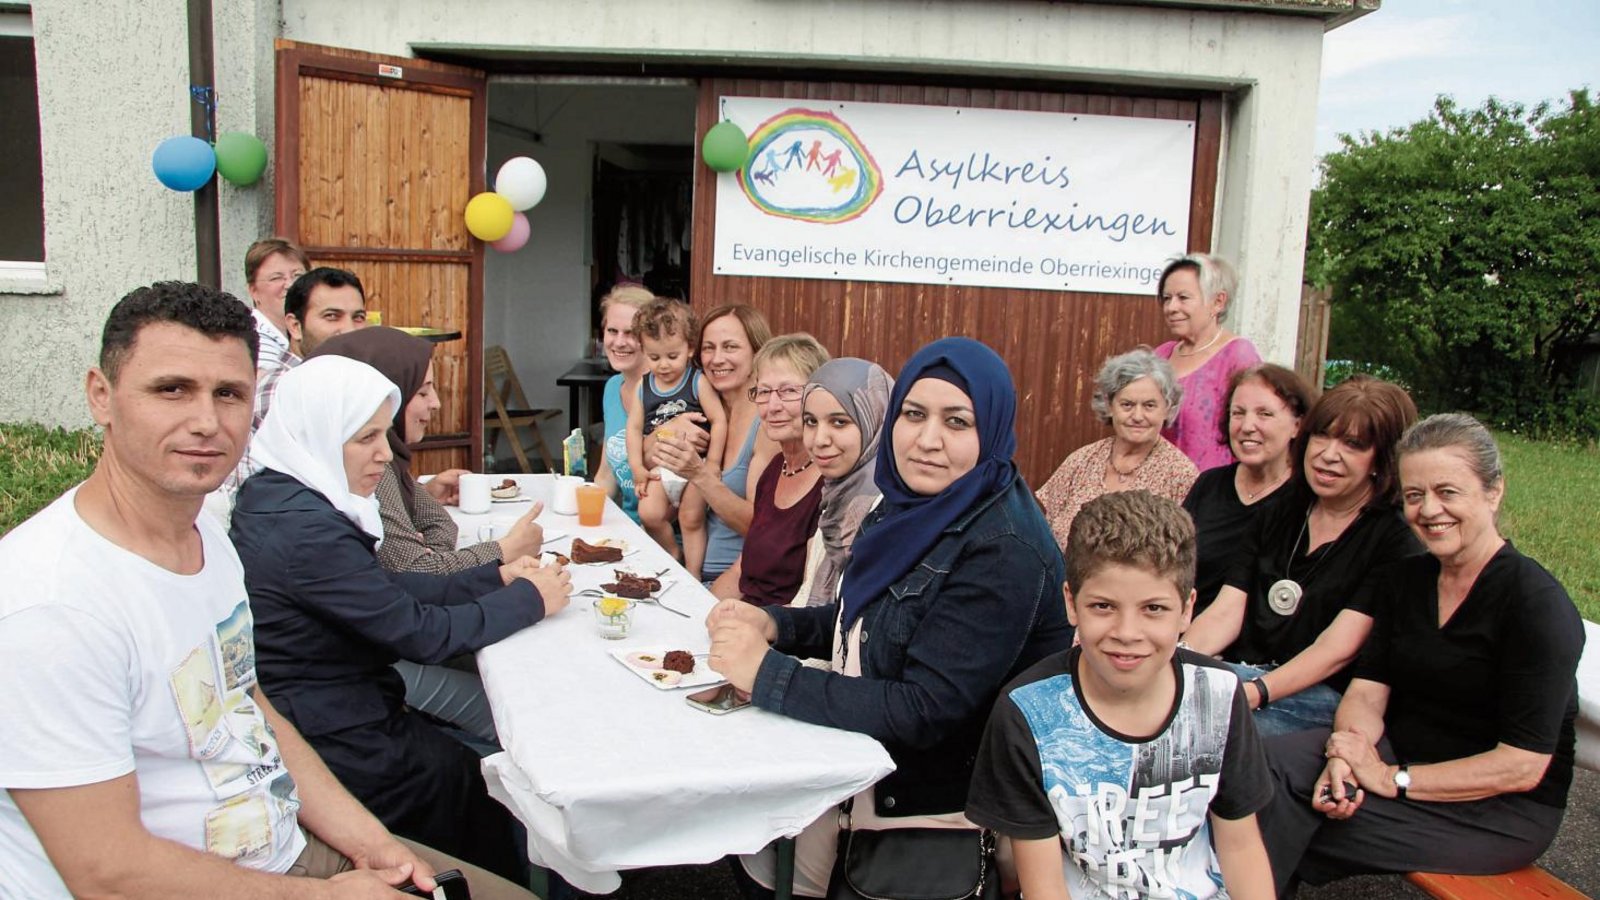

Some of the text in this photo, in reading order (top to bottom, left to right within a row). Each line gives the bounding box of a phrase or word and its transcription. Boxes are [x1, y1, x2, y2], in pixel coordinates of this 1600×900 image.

[895, 149, 1070, 189] Asylkreis
[893, 195, 1177, 242] Oberriexingen
[732, 243, 1163, 285] Evangelische Kirchengemeinde Oberriexinge
